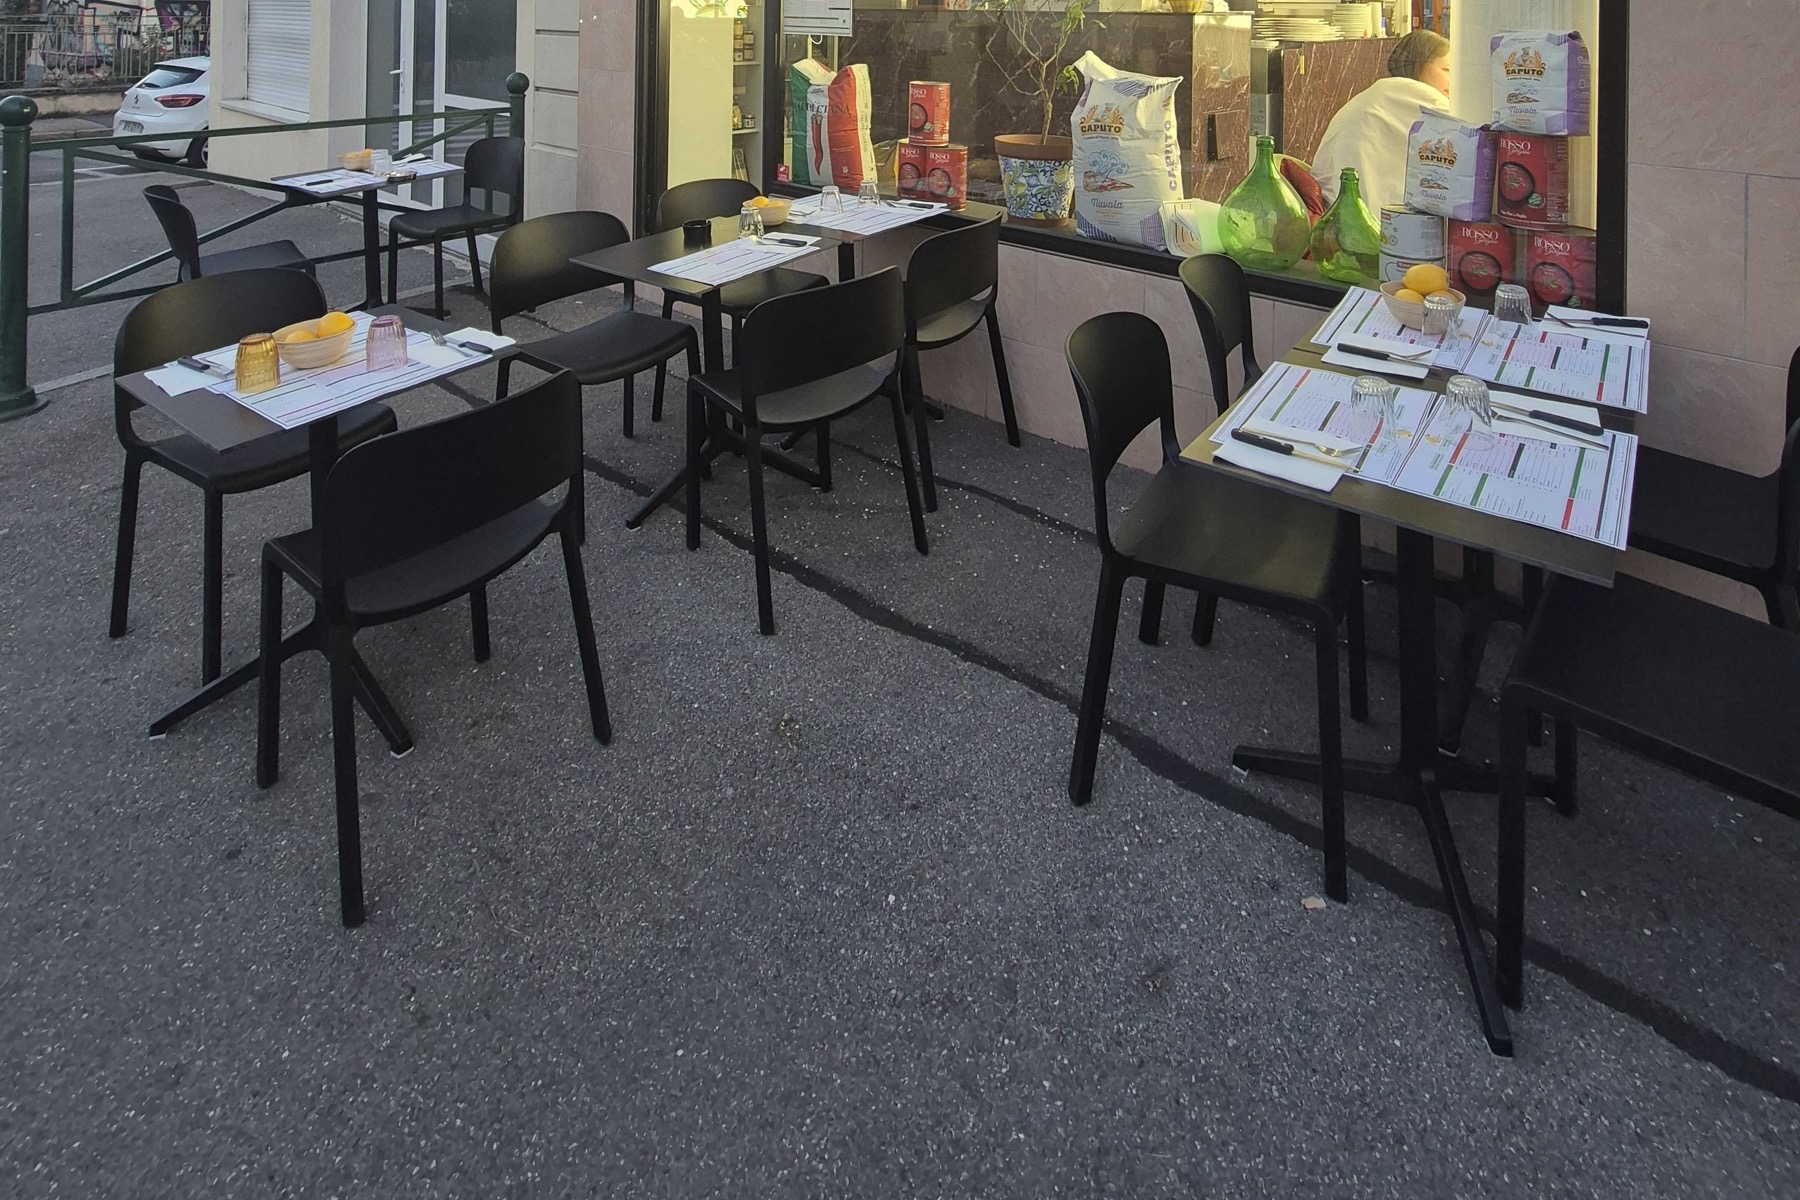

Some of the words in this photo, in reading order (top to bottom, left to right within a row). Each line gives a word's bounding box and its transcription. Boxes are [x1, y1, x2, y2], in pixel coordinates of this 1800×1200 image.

[1505, 67, 1543, 77] CAPUTO
[1080, 123, 1122, 135] CAPUTO
[1500, 137, 1531, 152] ROSSO
[1164, 120, 1178, 192] CAPUTO
[1419, 153, 1455, 166] CAPUTO
[1420, 189, 1447, 201] Nuvola
[1090, 197, 1125, 209] Nuvola
[1462, 227, 1499, 242] ROSSO
[1533, 236, 1570, 253] ROSSO
